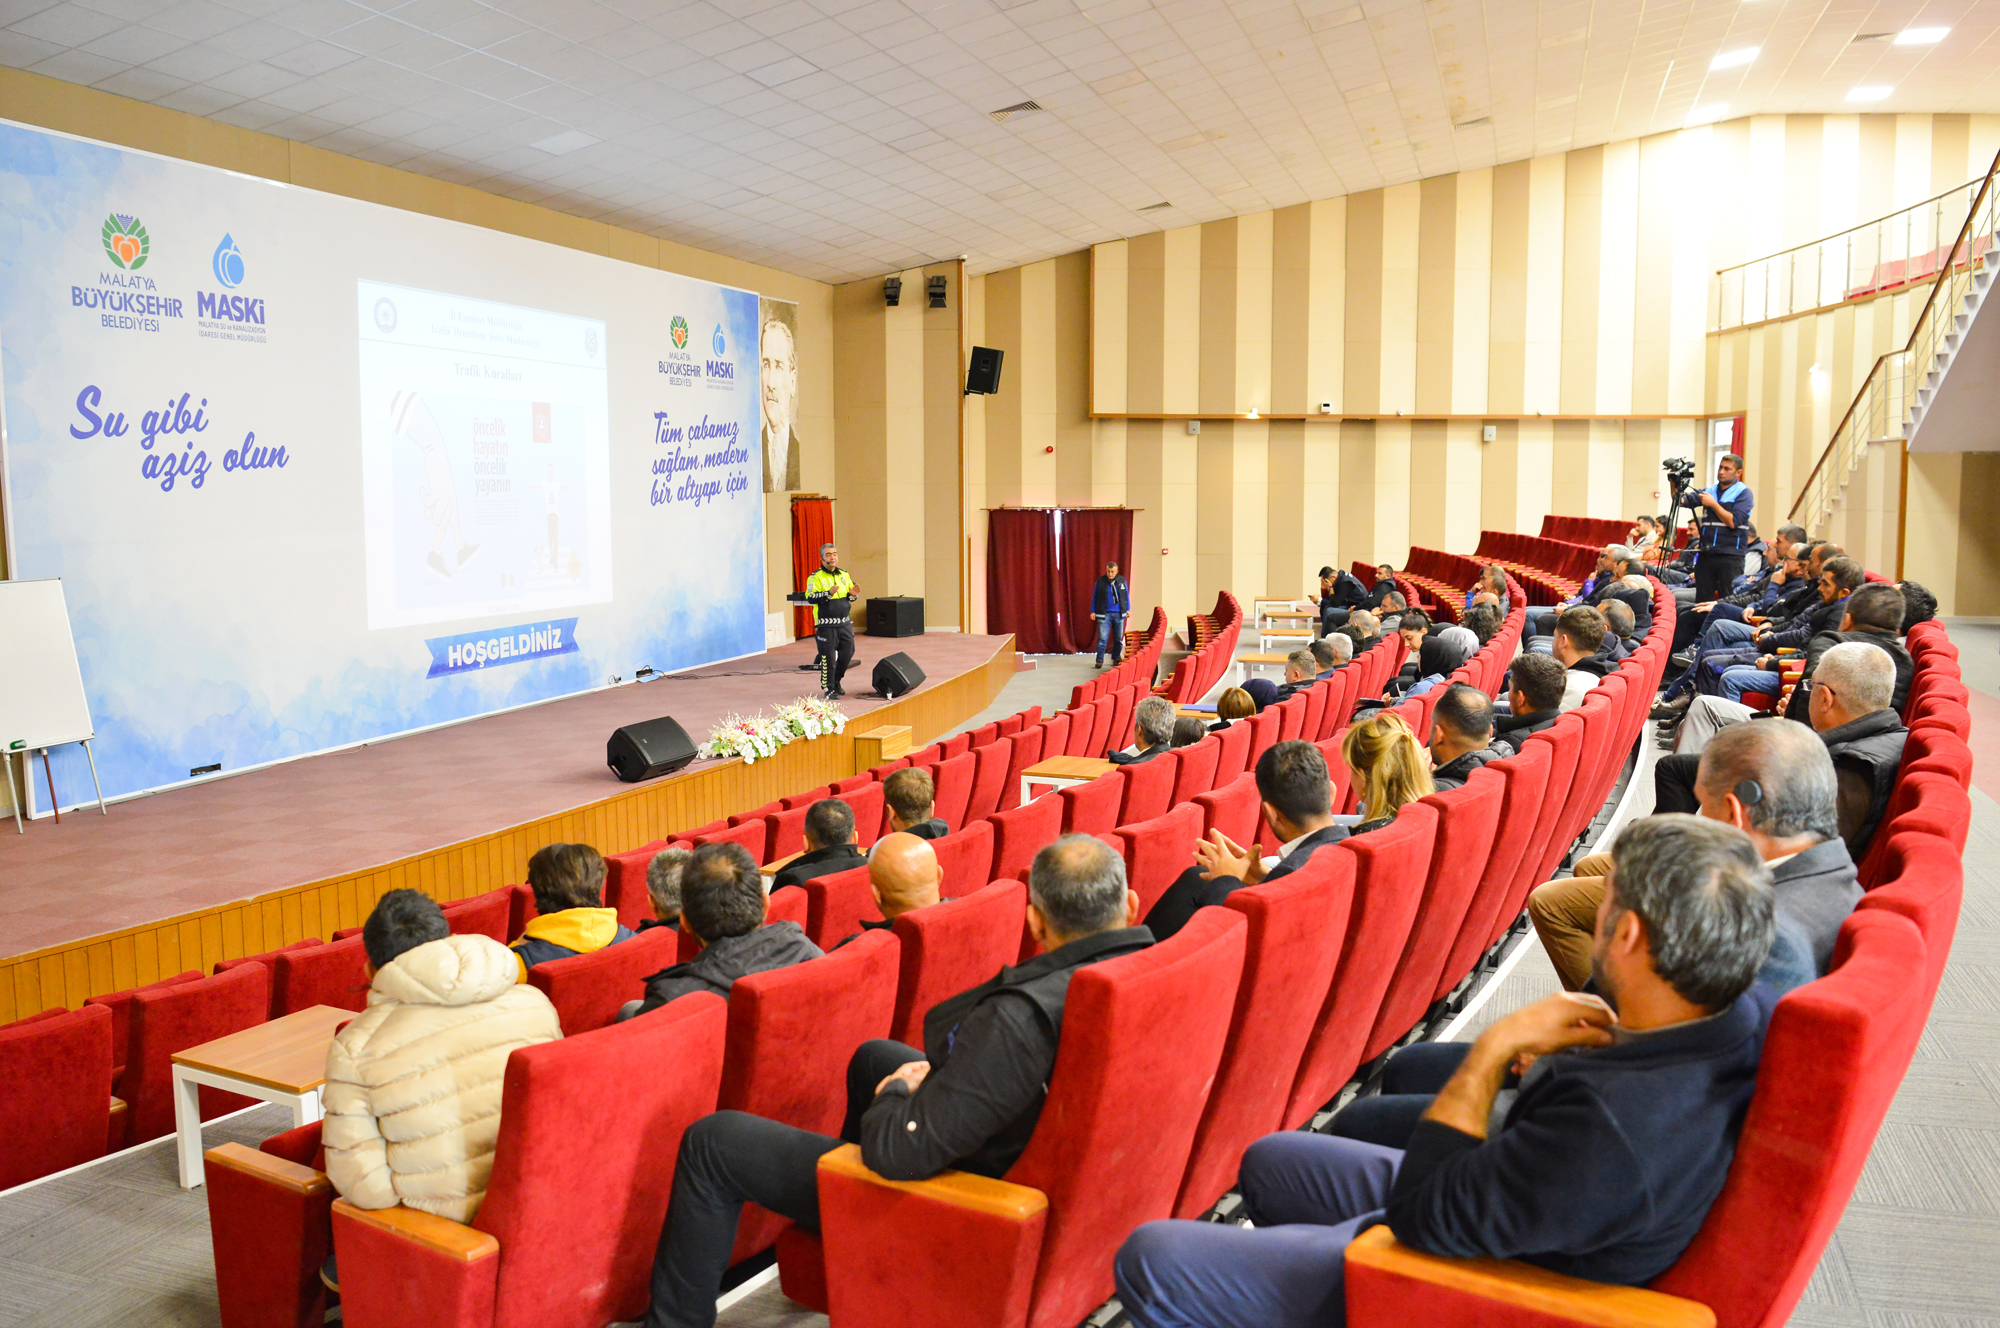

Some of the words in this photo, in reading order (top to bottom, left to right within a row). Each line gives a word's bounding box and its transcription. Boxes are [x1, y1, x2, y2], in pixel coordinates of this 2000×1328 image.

[100, 272, 157, 291] MALATYA
[669, 352, 691, 362] MALATYA
[454, 362, 481, 378] Trafik
[483, 366, 522, 381] Kuralları
[70, 385, 129, 439] Su
[140, 392, 209, 450] gibi
[473, 417, 506, 437] öncelik
[654, 411, 684, 444] Tüm
[688, 414, 739, 449] çabamız
[473, 436, 508, 460] hayatın
[142, 441, 212, 492] aziz
[223, 431, 290, 472] olun
[474, 457, 507, 475] öncelik
[475, 478, 511, 497] yayanın
[651, 479, 673, 506] bir
[677, 474, 722, 507] altyapı
[726, 470, 748, 499] için
[448, 624, 562, 668] HOŞGELDİNİZ
